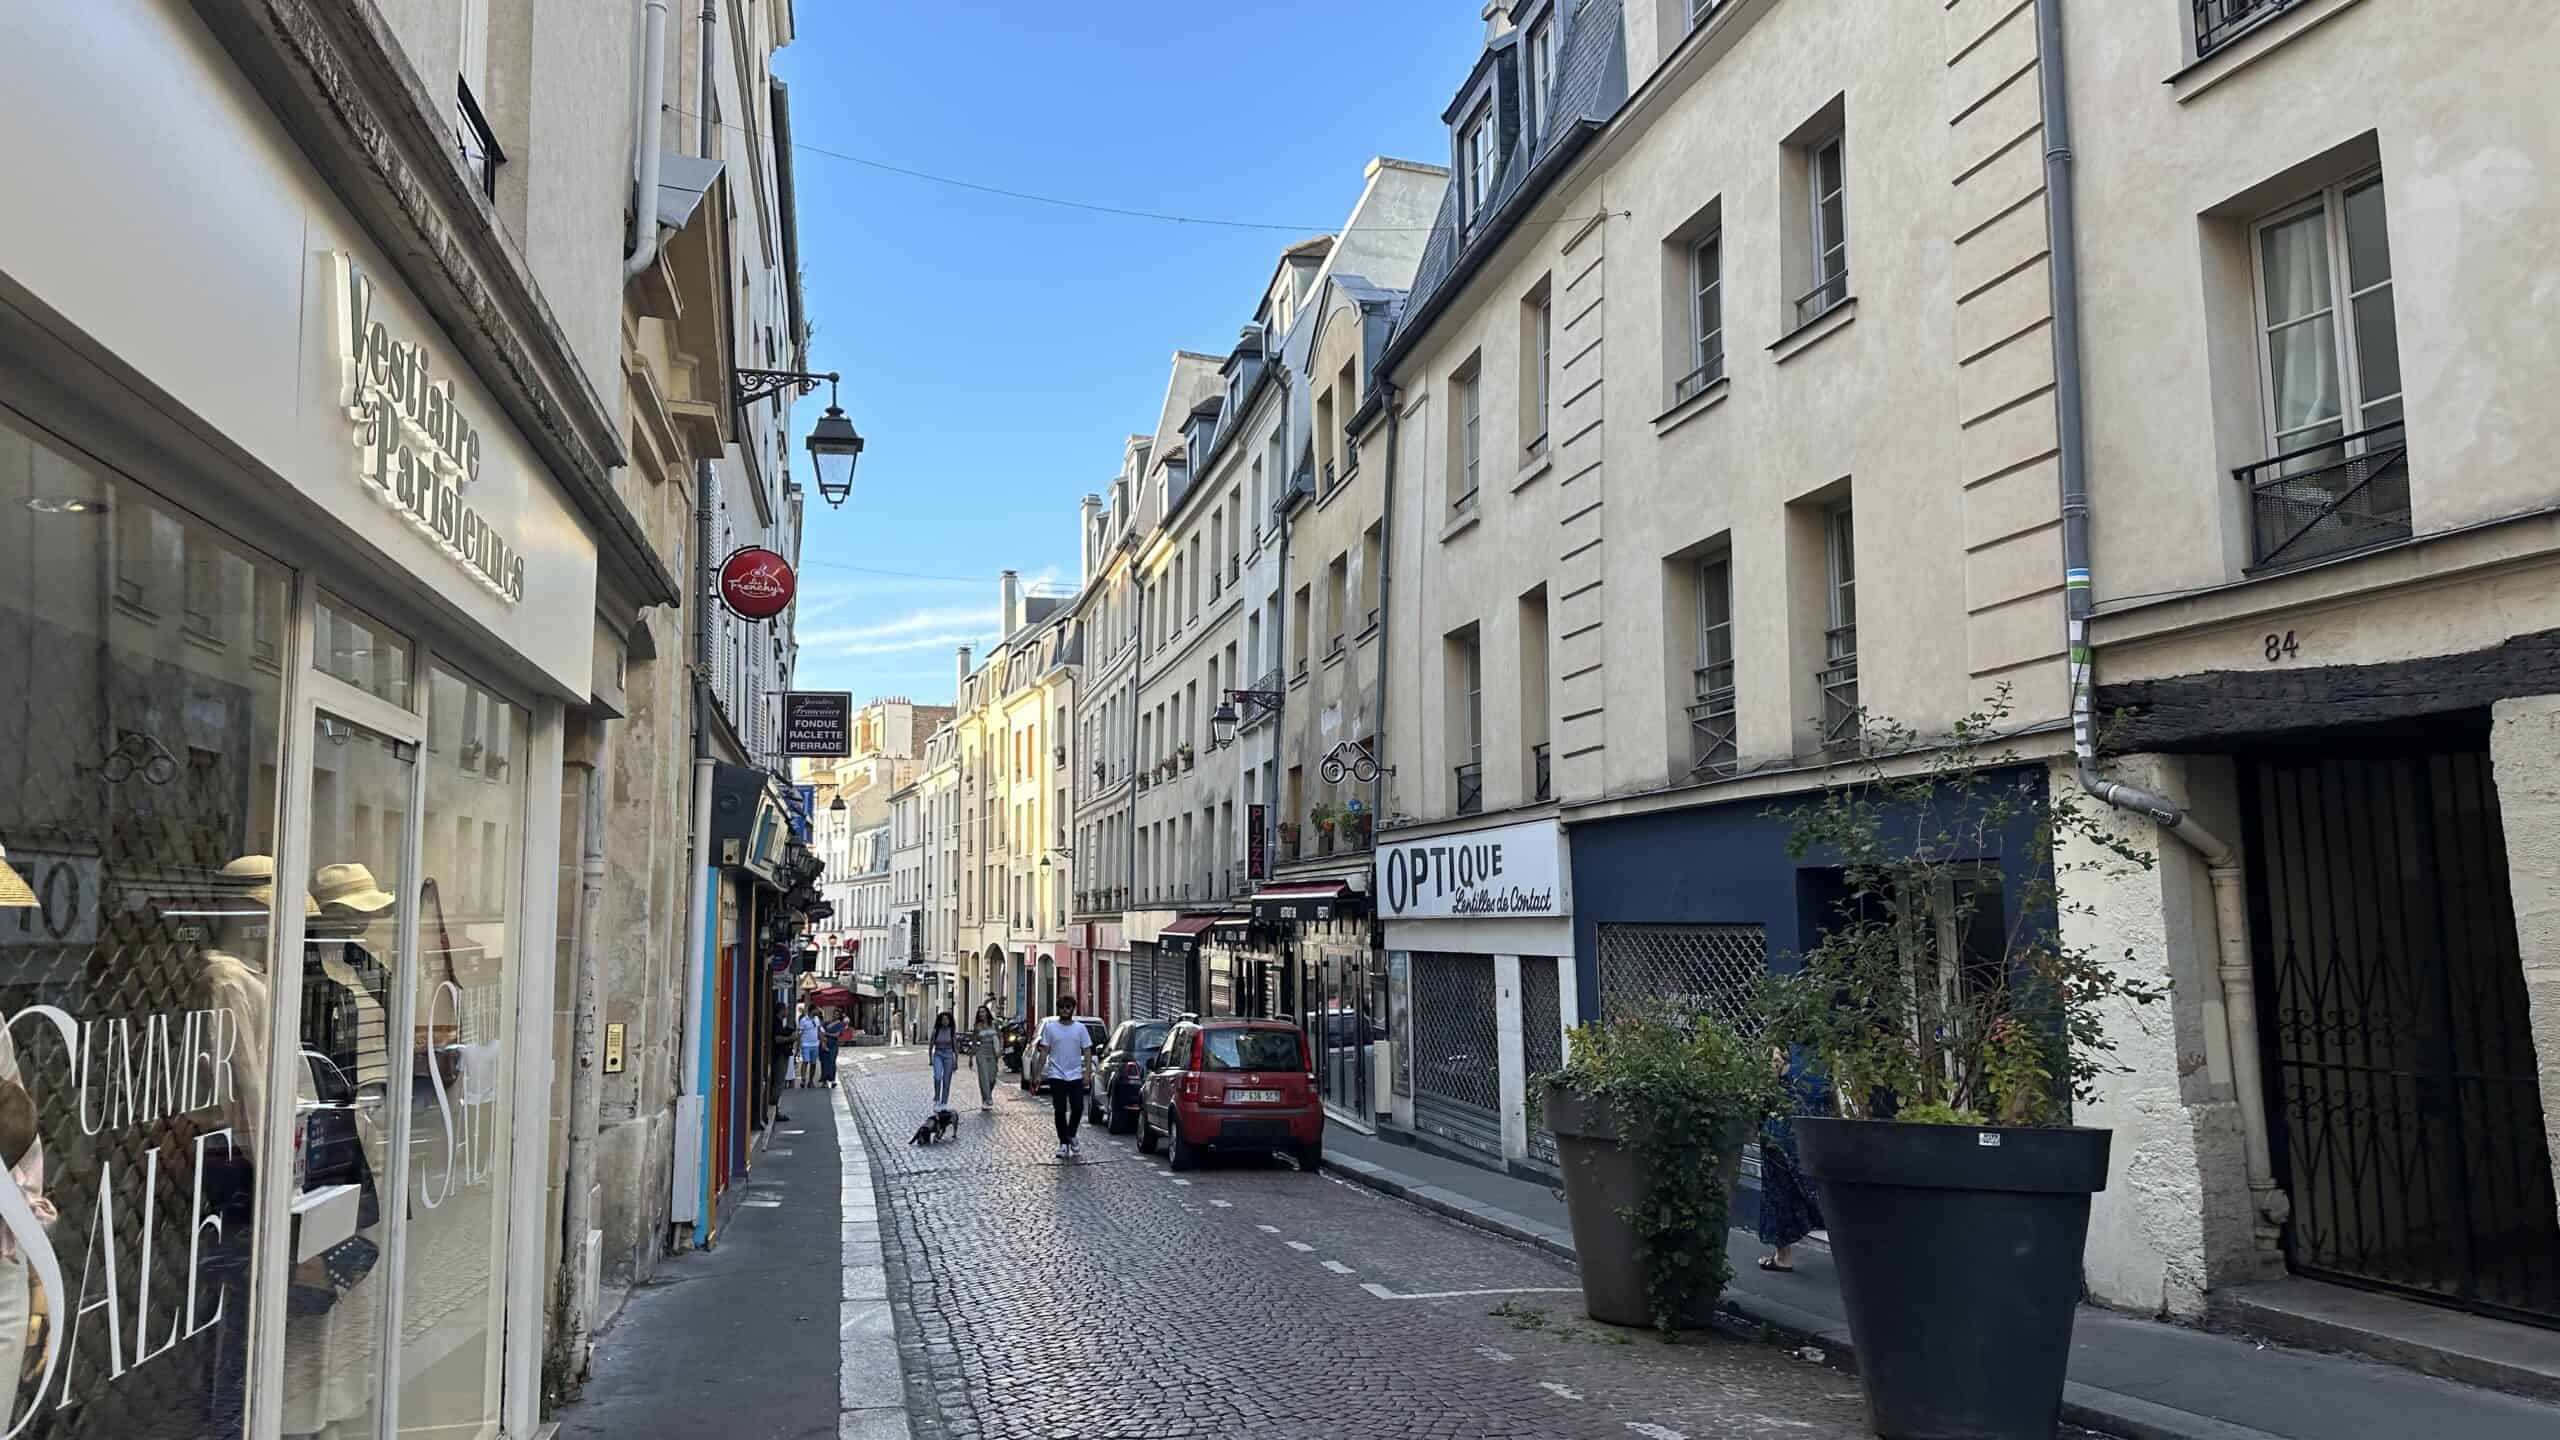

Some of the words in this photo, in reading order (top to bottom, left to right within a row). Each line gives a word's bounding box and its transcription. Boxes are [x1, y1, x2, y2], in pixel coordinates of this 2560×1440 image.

[344, 250, 480, 482] Vestiaire
[373, 388, 524, 603] Parisiennes
[2265, 630, 2299, 662] 84
[789, 730, 844, 739] RACLETTE
[795, 719, 838, 728] FONDUE
[790, 741, 842, 750] PIERRADE
[1252, 806, 1263, 876] PIZZA
[1387, 844, 1503, 914] OPTIQUE
[1452, 886, 1496, 914] Lentilles
[1497, 888, 1509, 912] de
[1510, 886, 1552, 913] Contact
